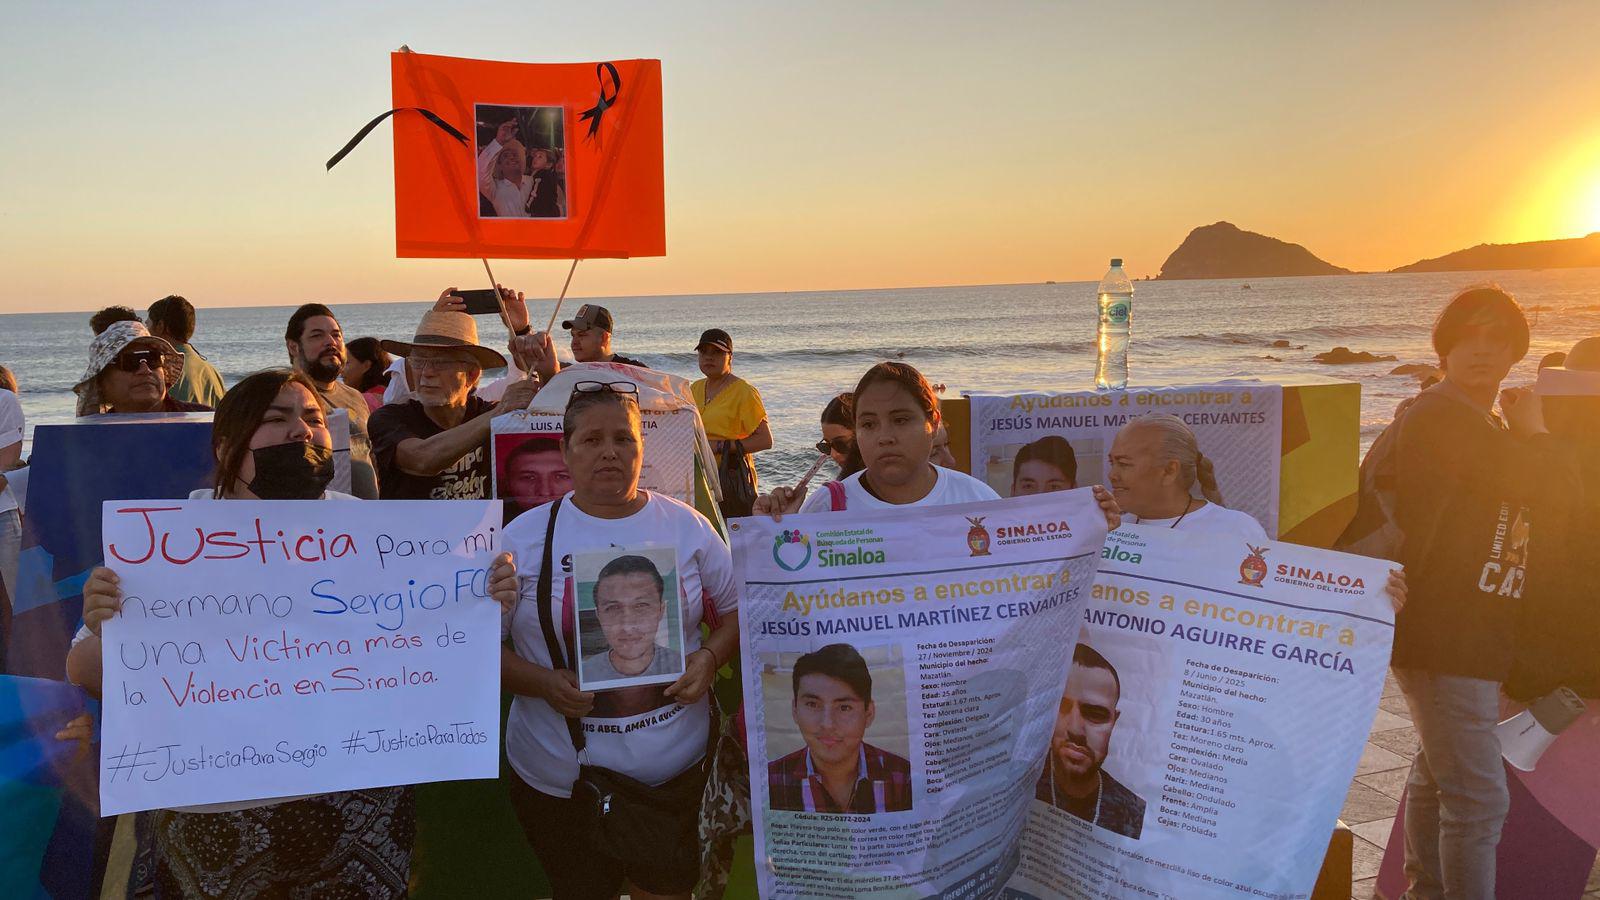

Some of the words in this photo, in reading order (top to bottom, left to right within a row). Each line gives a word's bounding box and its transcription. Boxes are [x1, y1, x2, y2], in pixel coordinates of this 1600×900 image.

[1119, 395, 1130, 408] a
[1134, 390, 1233, 406] encontrar
[1241, 392, 1252, 404] a
[530, 422, 552, 430] LUIS
[642, 420, 658, 429] TIA
[990, 414, 1032, 431] JESÚS
[1036, 414, 1099, 429] MANUEL
[1182, 412, 1266, 426] CERVANTES
[109, 506, 357, 565] Justicia
[376, 532, 451, 569] para
[464, 527, 494, 553] mi
[996, 521, 1070, 539] SINALOA
[997, 537, 1031, 546] GOBIERNO
[1047, 532, 1072, 540] ESTADO
[856, 536, 884, 544] Personas
[1116, 538, 1146, 547] Personas
[1490, 523, 1507, 559] LIMITED
[818, 546, 885, 568] Sinaloa
[1101, 545, 1142, 564] aloa
[1274, 577, 1315, 588] GOBIERNO
[1276, 564, 1365, 588] SINALOA
[782, 586, 906, 616] Ayúdanos
[913, 585, 928, 601] a
[934, 572, 1057, 600] encontrar
[1060, 568, 1071, 586] a
[310, 579, 446, 631] Sergio
[761, 618, 812, 636] JESÚS
[816, 616, 894, 636] MANUEL
[898, 604, 992, 628] MARTÍNEZ
[996, 586, 1081, 620] CERVANTES
[1090, 584, 1151, 606] anos
[1159, 594, 1175, 611] a
[1184, 598, 1330, 640] encontrar
[1338, 628, 1355, 646] a
[436, 623, 466, 648] de
[949, 638, 995, 647] Desaparición:
[933, 649, 970, 658] Noviembre
[977, 647, 993, 655] 2024
[1170, 623, 1267, 655] AGUIRRE
[1271, 643, 1354, 675] GARCÍA
[920, 660, 953, 670] Municipio
[1186, 659, 1209, 669] Fecha
[1211, 664, 1221, 672] de
[1223, 667, 1280, 684] Desaparición:
[122, 681, 146, 706] la
[162, 670, 281, 707] Violencia
[294, 679, 325, 695] en
[331, 666, 439, 692] Sinaloa.
[941, 680, 967, 688] Hombre
[1196, 672, 1217, 681] Junio
[1225, 678, 1246, 687] 2025
[1183, 679, 1222, 693] Municipio
[1224, 688, 1237, 697] del
[1239, 691, 1267, 703] hecho:
[938, 709, 962, 717] Morena
[1178, 700, 1200, 710] Sexo:
[1202, 705, 1234, 718] Hombre
[598, 725, 622, 734] ABEL
[625, 716, 658, 733] AMAYA
[1176, 710, 1199, 721] Edad:
[1201, 716, 1211, 724] 30
[1212, 718, 1232, 729] años
[1173, 731, 1188, 740] Tez:
[1190, 736, 1222, 748] Moreno
[107, 740, 328, 783] #JusticiaParaSergio
[1169, 753, 1188, 763] Cara:
[1191, 758, 1224, 771] Ovalado
[1171, 742, 1220, 759] Complexión:
[1222, 754, 1248, 766] Media
[1167, 763, 1187, 774] Ojos:
[1189, 768, 1228, 783] Medianos
[1164, 774, 1188, 785] Nariz:
[1190, 780, 1224, 794] Mediana
[1161, 795, 1189, 808] Frente:
[1190, 802, 1218, 816] Amplia
[1163, 784, 1194, 798] Cabello:
[1196, 792, 1236, 808] Ondulado
[1160, 805, 1180, 816] Boca:
[1182, 812, 1217, 826] Mediana
[1157, 816, 1180, 828] Cejas:
[1181, 823, 1217, 838] Pobladas
[1202, 874, 1212, 882] de
[1214, 877, 1234, 888] color
[1234, 882, 1252, 894] azul
